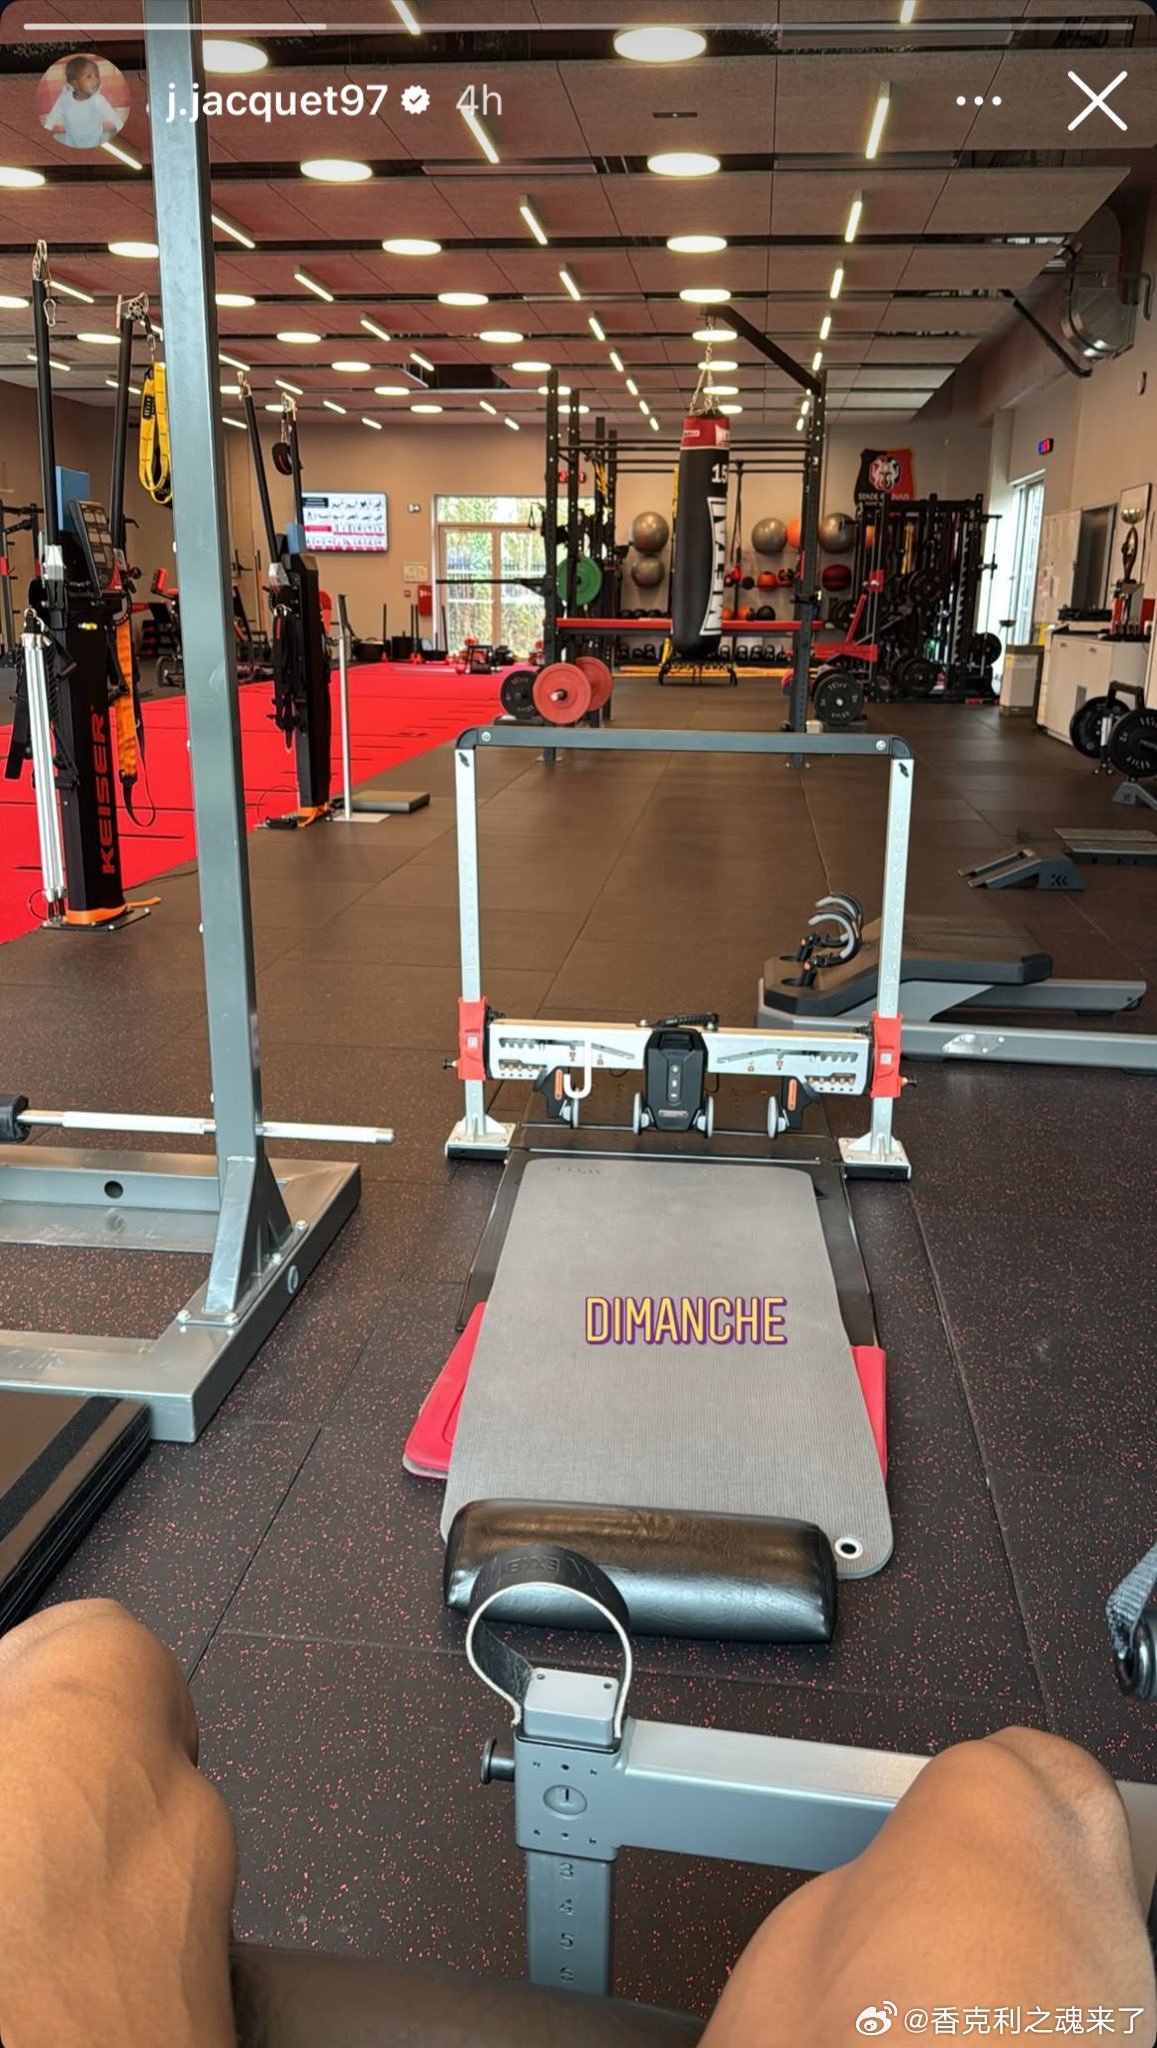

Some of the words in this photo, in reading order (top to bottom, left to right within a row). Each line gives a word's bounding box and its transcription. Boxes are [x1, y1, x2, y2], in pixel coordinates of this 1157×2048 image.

[91, 712, 116, 874] KEISER
[559, 1861, 575, 1880] 3
[559, 1932, 575, 1951] 5
